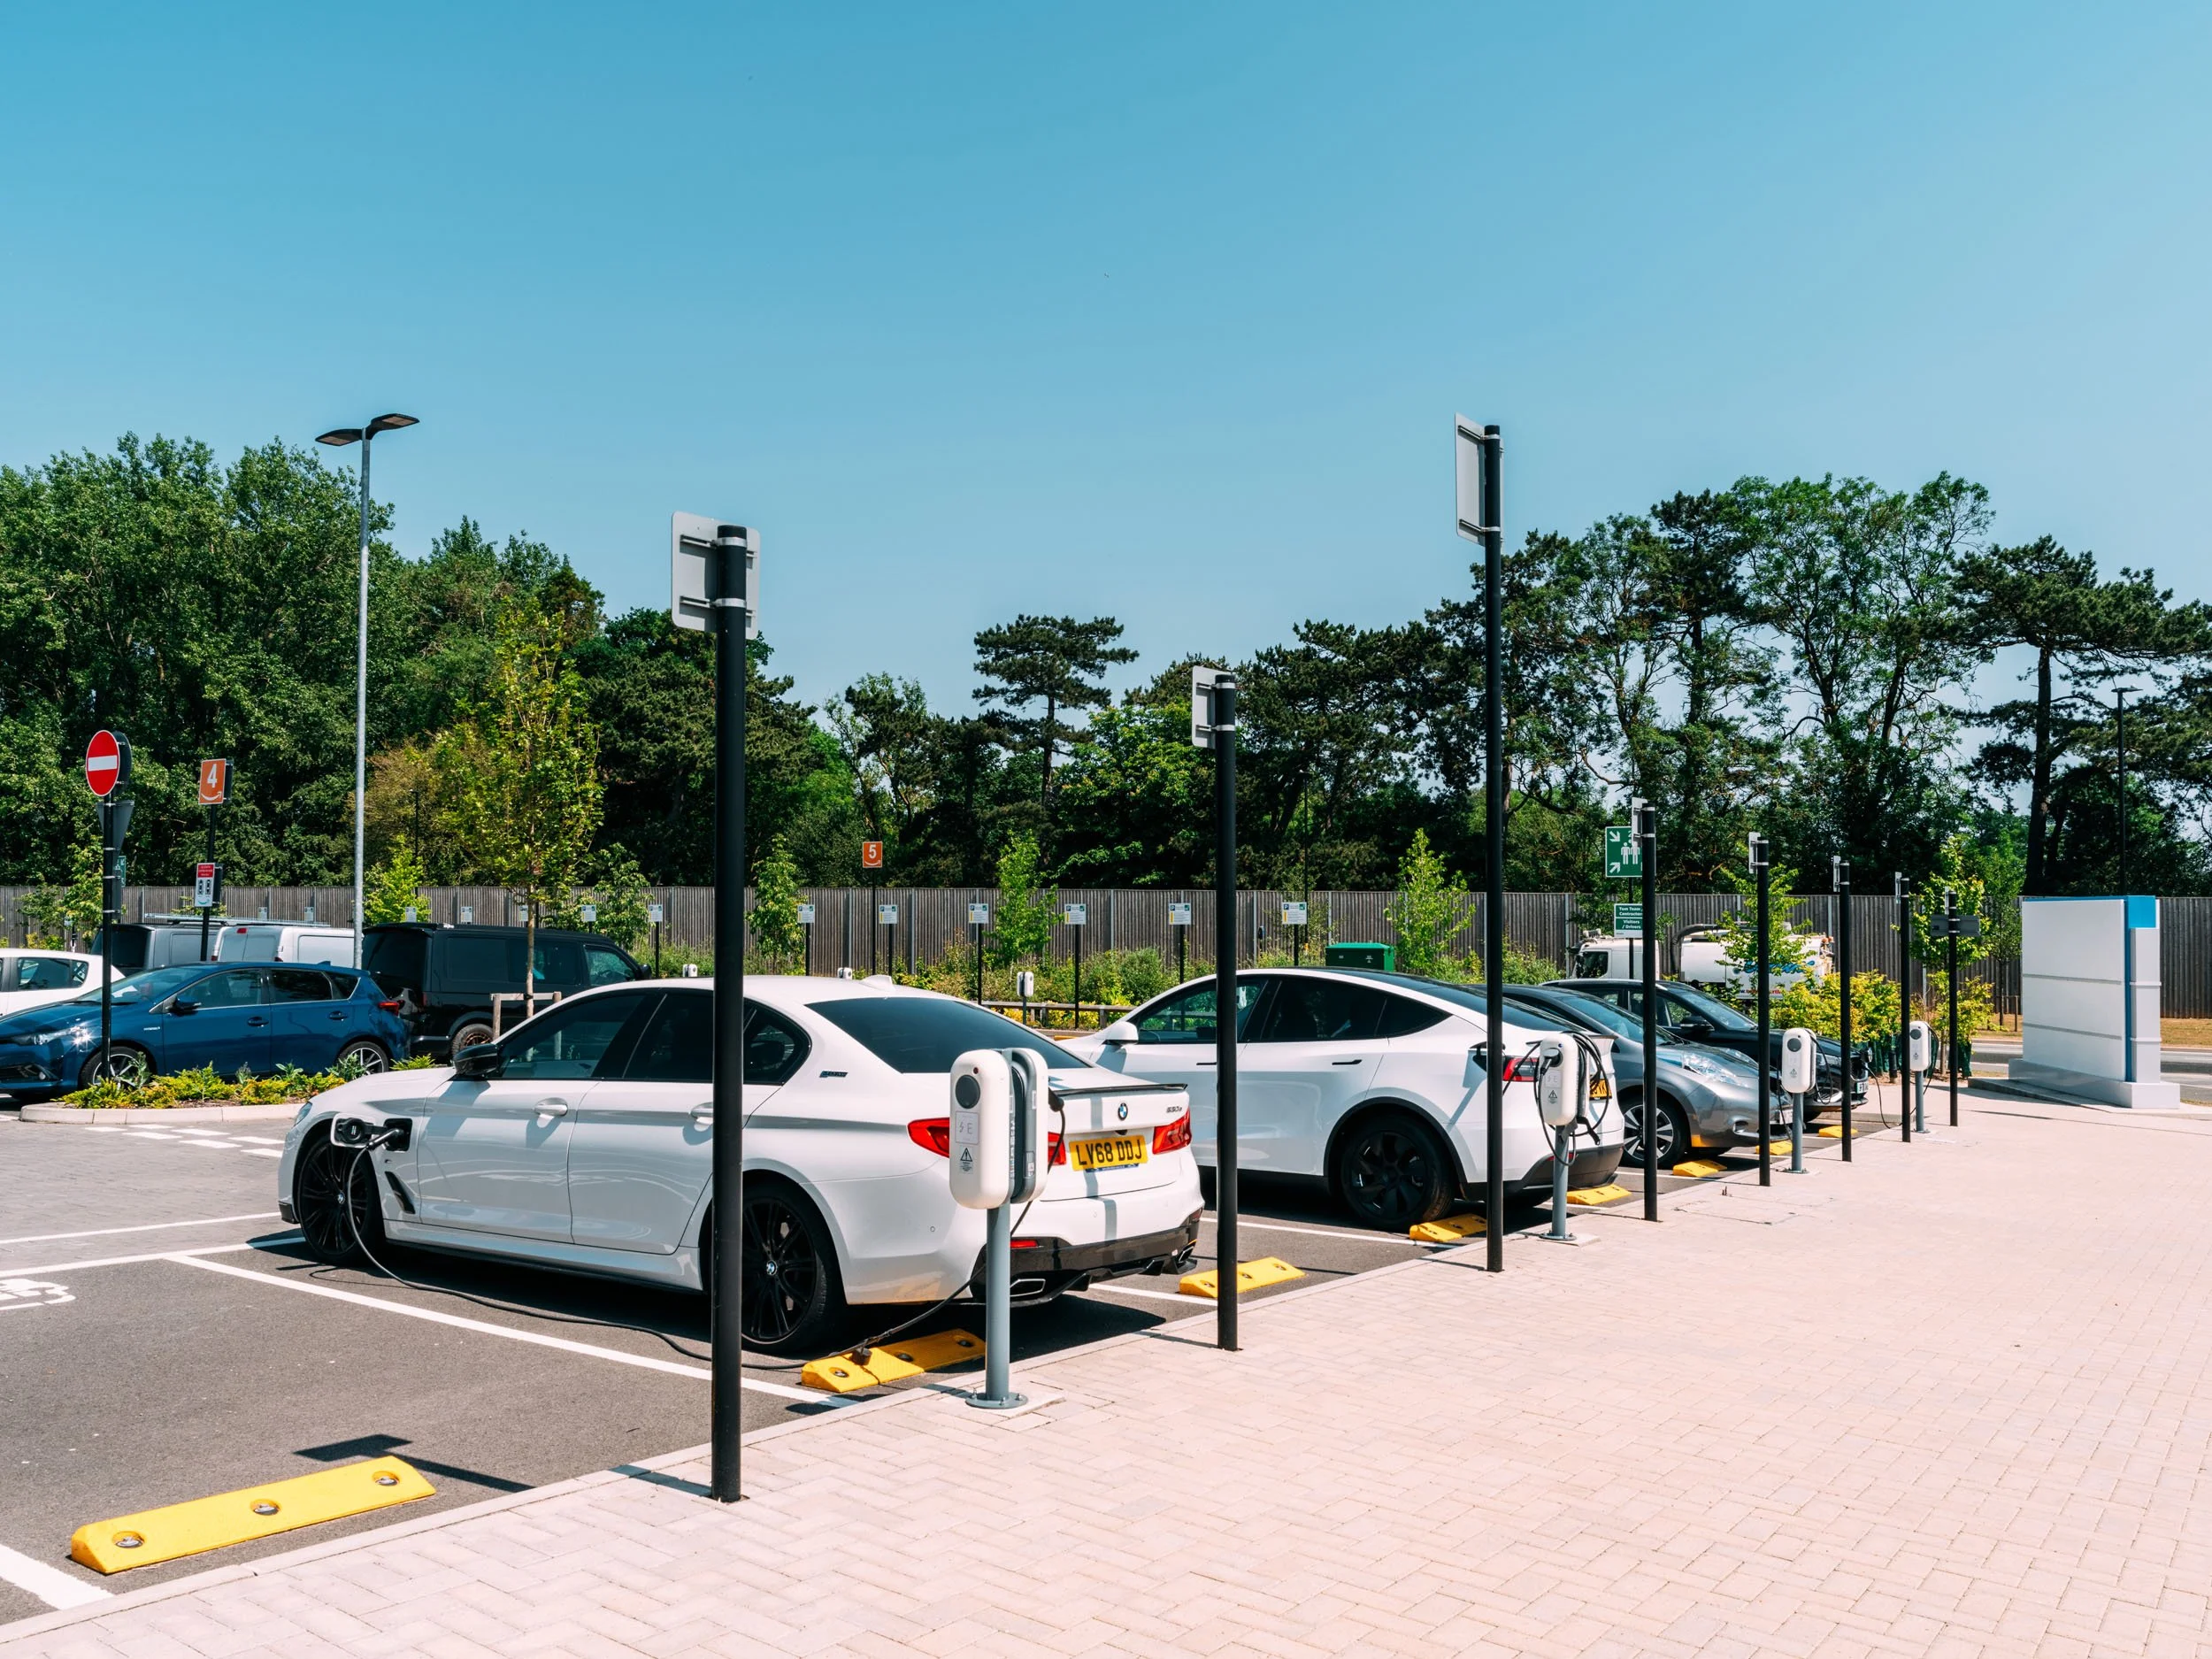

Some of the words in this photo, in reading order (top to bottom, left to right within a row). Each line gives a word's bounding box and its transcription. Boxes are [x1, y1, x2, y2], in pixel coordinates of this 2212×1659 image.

[207, 764, 218, 788] 4
[868, 844, 877, 859] 5
[967, 1123, 973, 1134] E
[1076, 1141, 1114, 1166] LV68
[1116, 1140, 1142, 1162] DDJ
